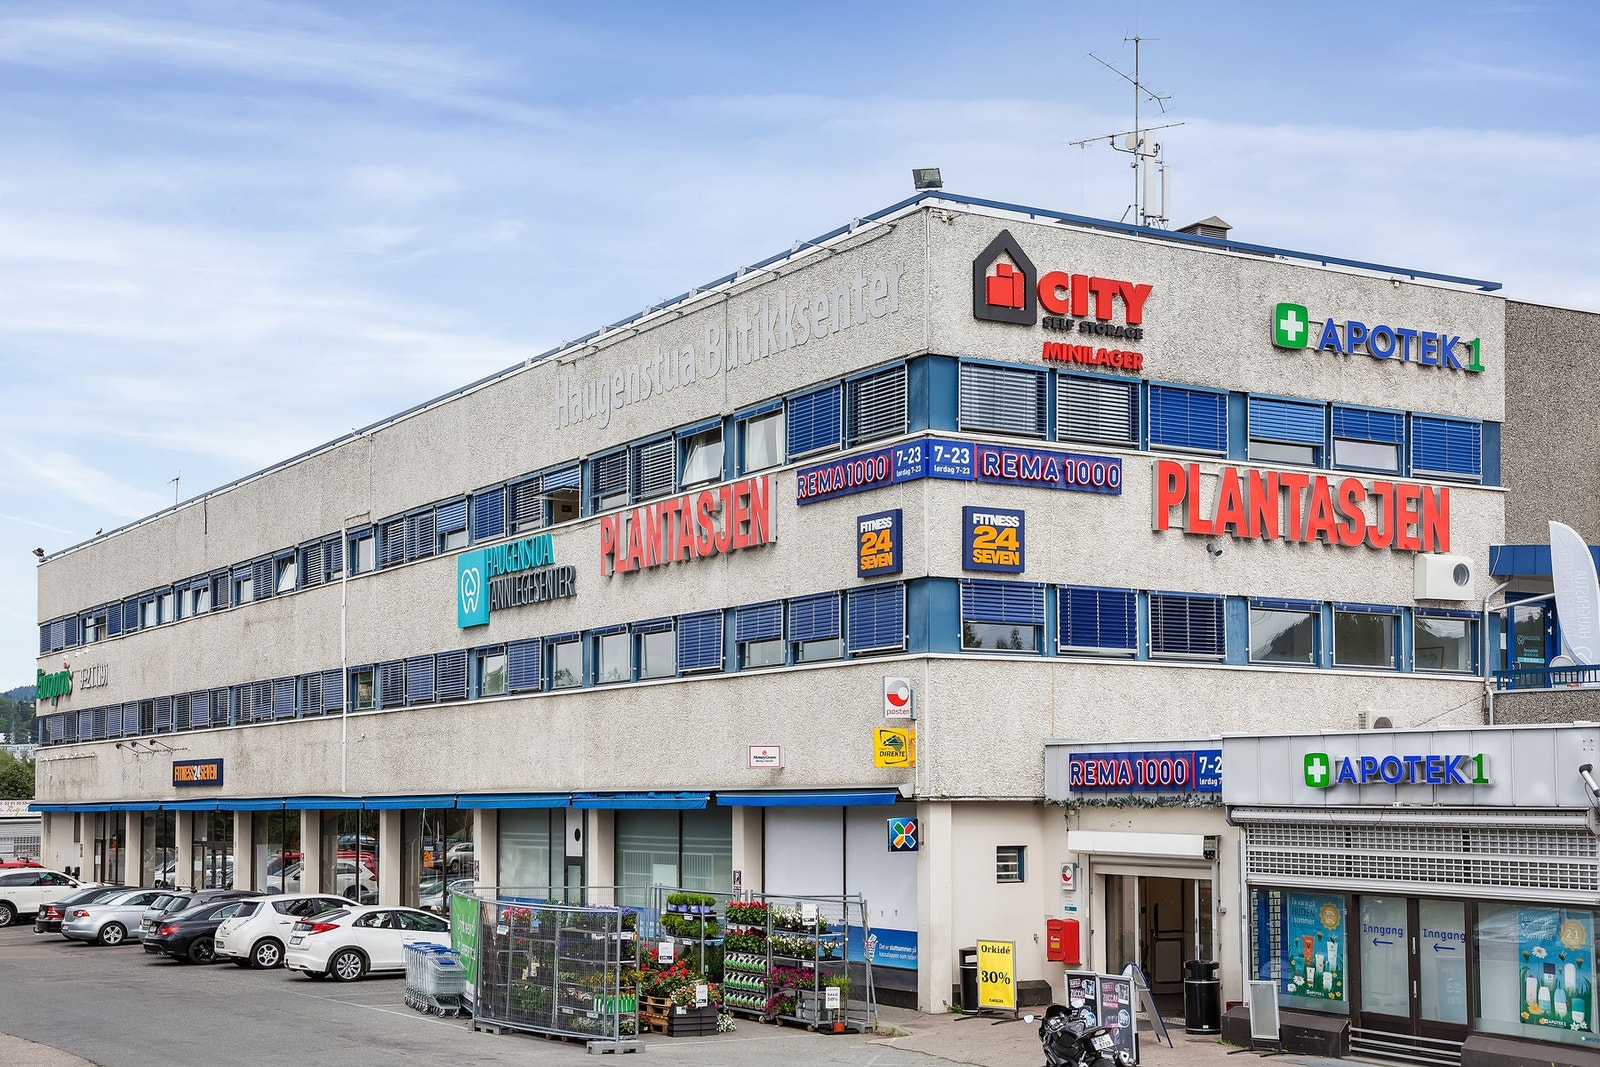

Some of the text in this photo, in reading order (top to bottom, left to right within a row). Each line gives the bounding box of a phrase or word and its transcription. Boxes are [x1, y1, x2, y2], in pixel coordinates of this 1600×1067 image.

[1037, 270, 1153, 325] CITY
[1042, 316, 1144, 340] SELF STORAGE
[554, 262, 904, 429] Haugenstua Butikksenter
[1042, 341, 1144, 371] MINILAGER
[1317, 317, 1486, 373] APOTEK 1
[896, 446, 922, 467] 7-23
[934, 446, 970, 465] 7-23
[796, 454, 888, 499] REMA 1000
[911, 465, 922, 475] 7-23
[956, 466, 971, 476] 7-23
[981, 451, 1121, 488] REMA 1000
[1152, 459, 1450, 553] PLANTASJEN
[600, 475, 772, 577] PLANTASJEN
[860, 517, 892, 533] FITNESS
[972, 513, 1020, 528] FITNESS
[860, 529, 892, 555] 24
[972, 526, 1019, 550] 24
[487, 533, 555, 577] HAUGENSTUA
[860, 554, 893, 571] SEVEN
[972, 550, 1020, 566] SEVEN
[488, 565, 577, 611] TANNLEGESENTER
[886, 708, 910, 716] posten
[1069, 757, 1190, 786] REMA 1000
[1337, 753, 1490, 785] APOTEK 1
[1291, 907, 1315, 917] HUDEN
[1294, 917, 1315, 925] sommer
[1363, 924, 1403, 938] Inngang
[1423, 928, 1466, 943] Inngang
[981, 944, 1011, 954] Orkidé
[981, 970, 1011, 985] 30%
